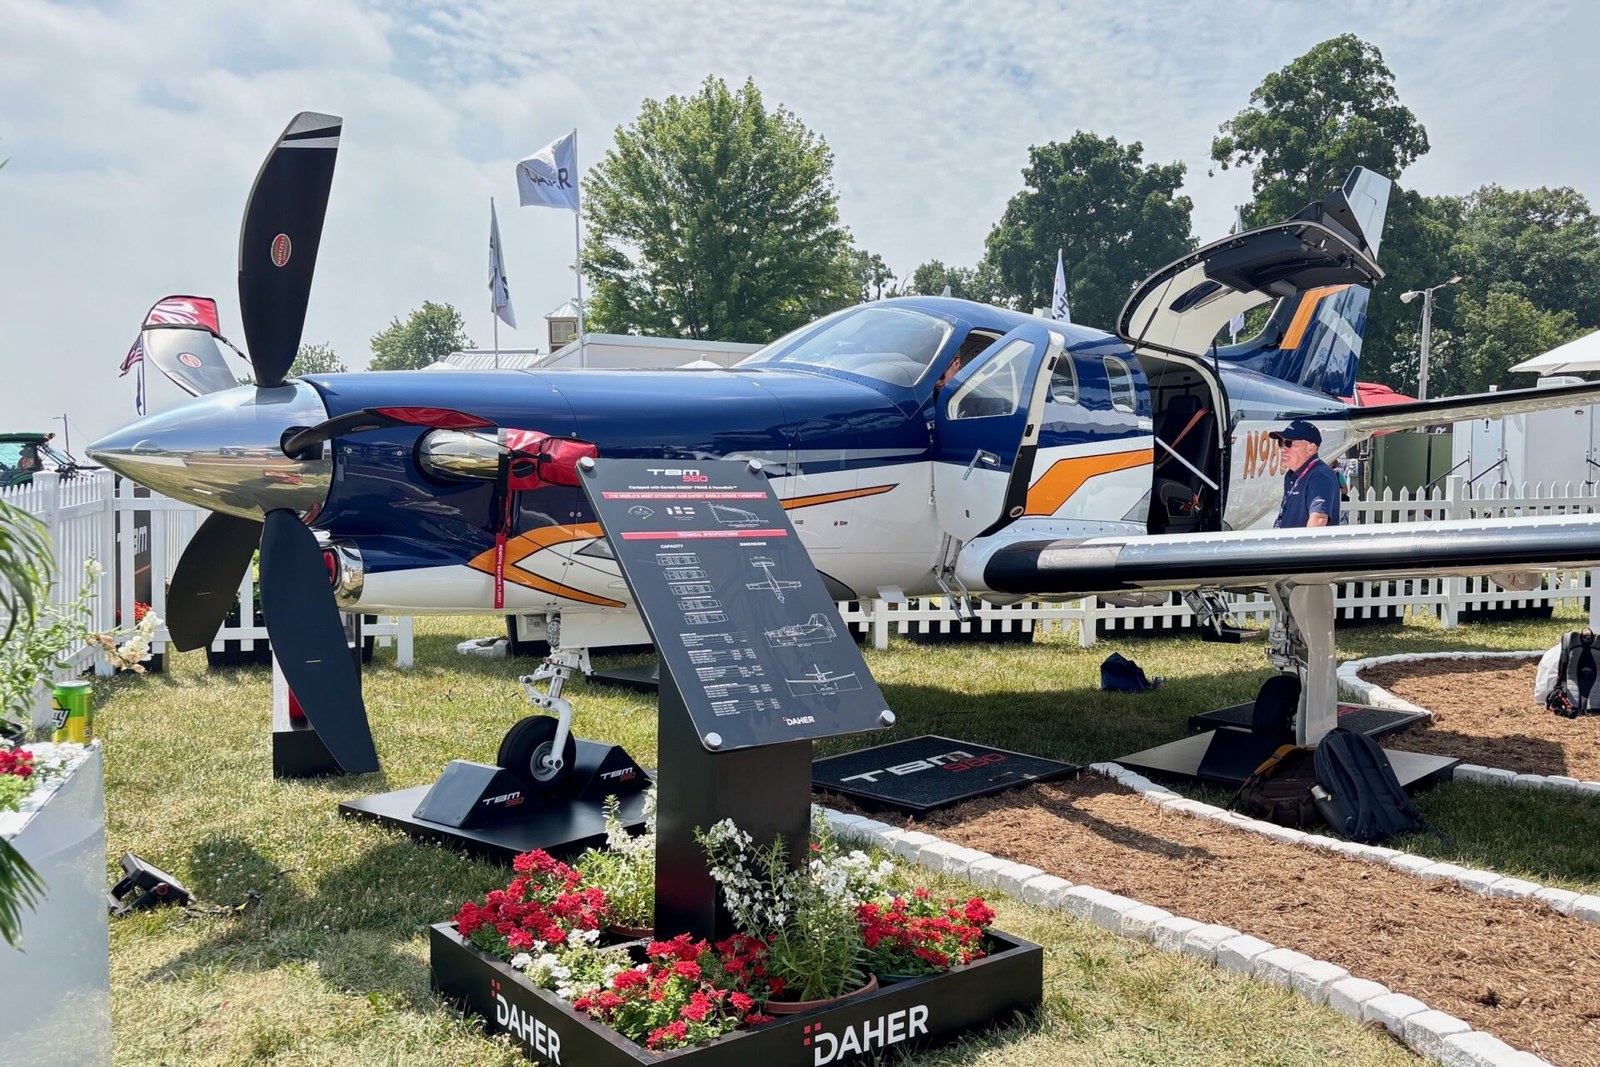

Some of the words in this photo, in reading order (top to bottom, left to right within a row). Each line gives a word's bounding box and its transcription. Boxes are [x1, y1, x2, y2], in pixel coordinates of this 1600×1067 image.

[785, 715, 816, 726] DAHER
[496, 993, 561, 1066] DAHER
[814, 1004, 929, 1067] DAHER
